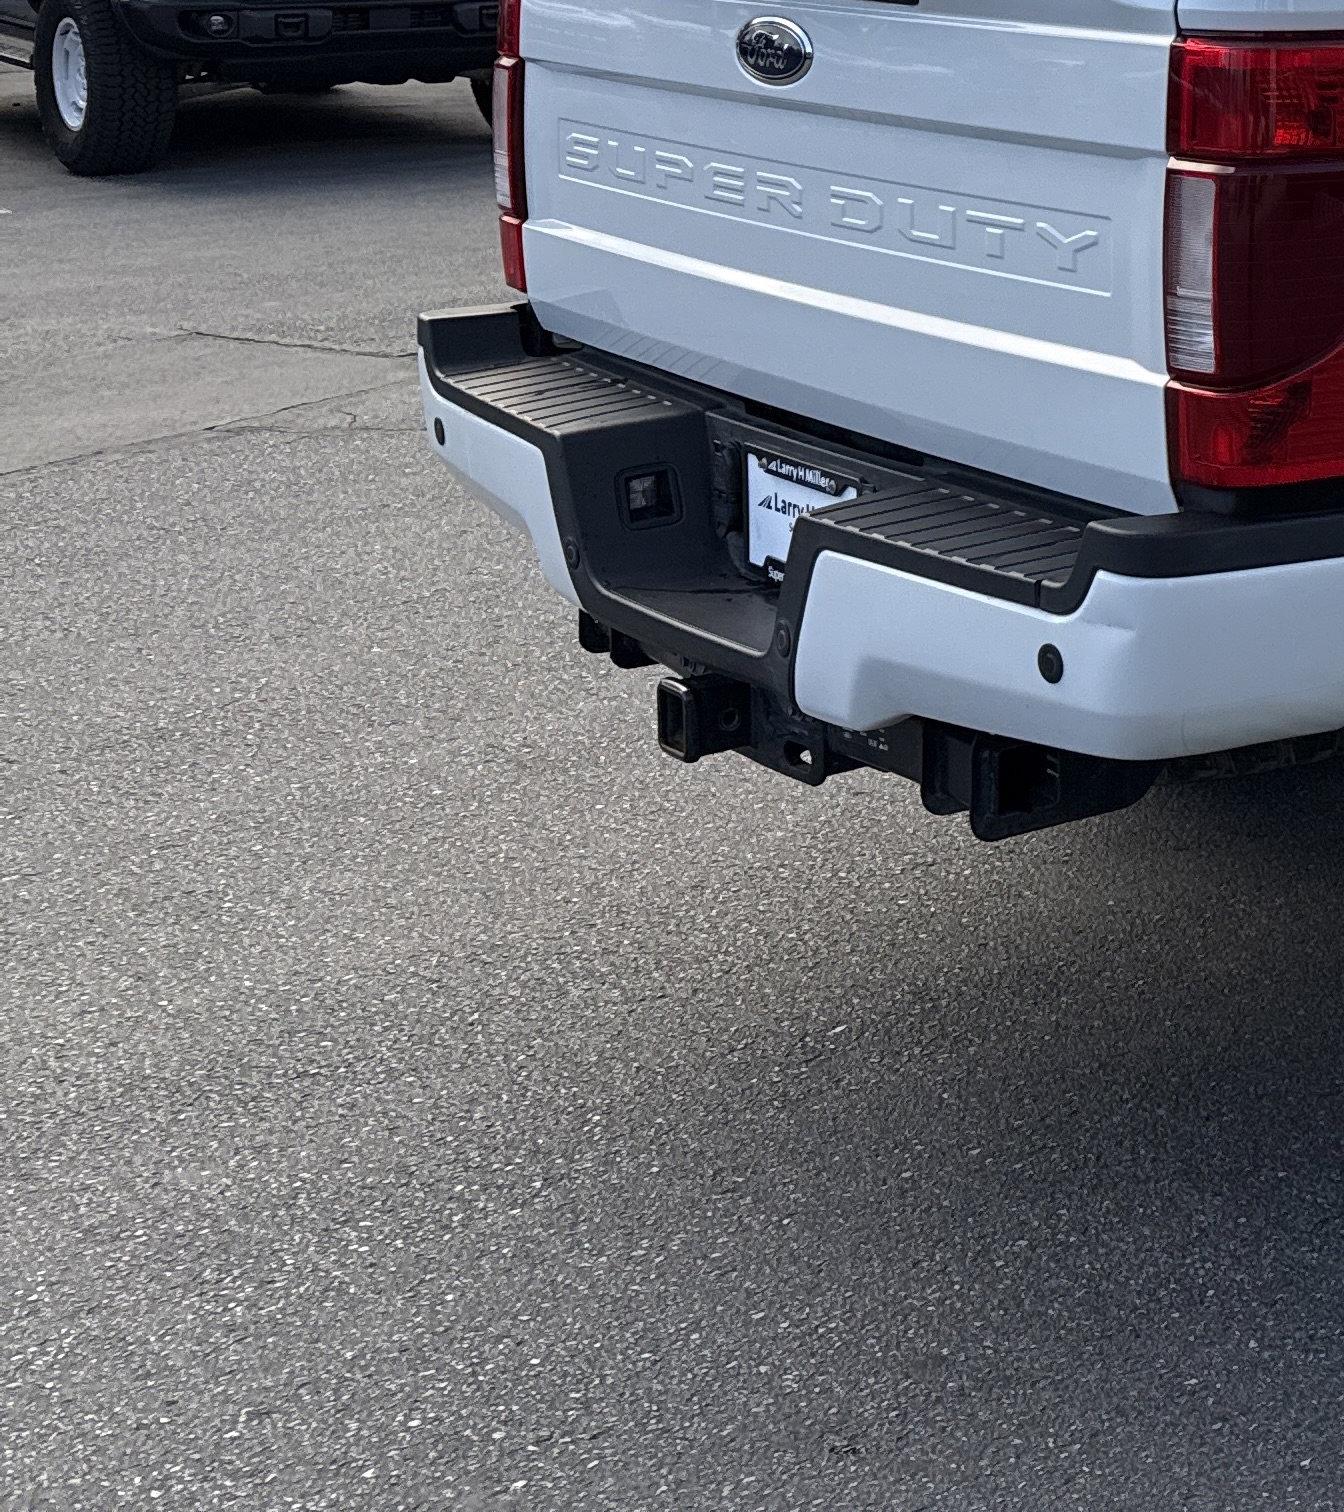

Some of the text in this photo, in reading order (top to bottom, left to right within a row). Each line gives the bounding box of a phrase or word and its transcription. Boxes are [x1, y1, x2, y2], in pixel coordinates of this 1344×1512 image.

[740, 29, 790, 70] Ford
[565, 131, 1100, 274] SUPER DUTY
[776, 458, 798, 481] Larry
[797, 465, 805, 481] H
